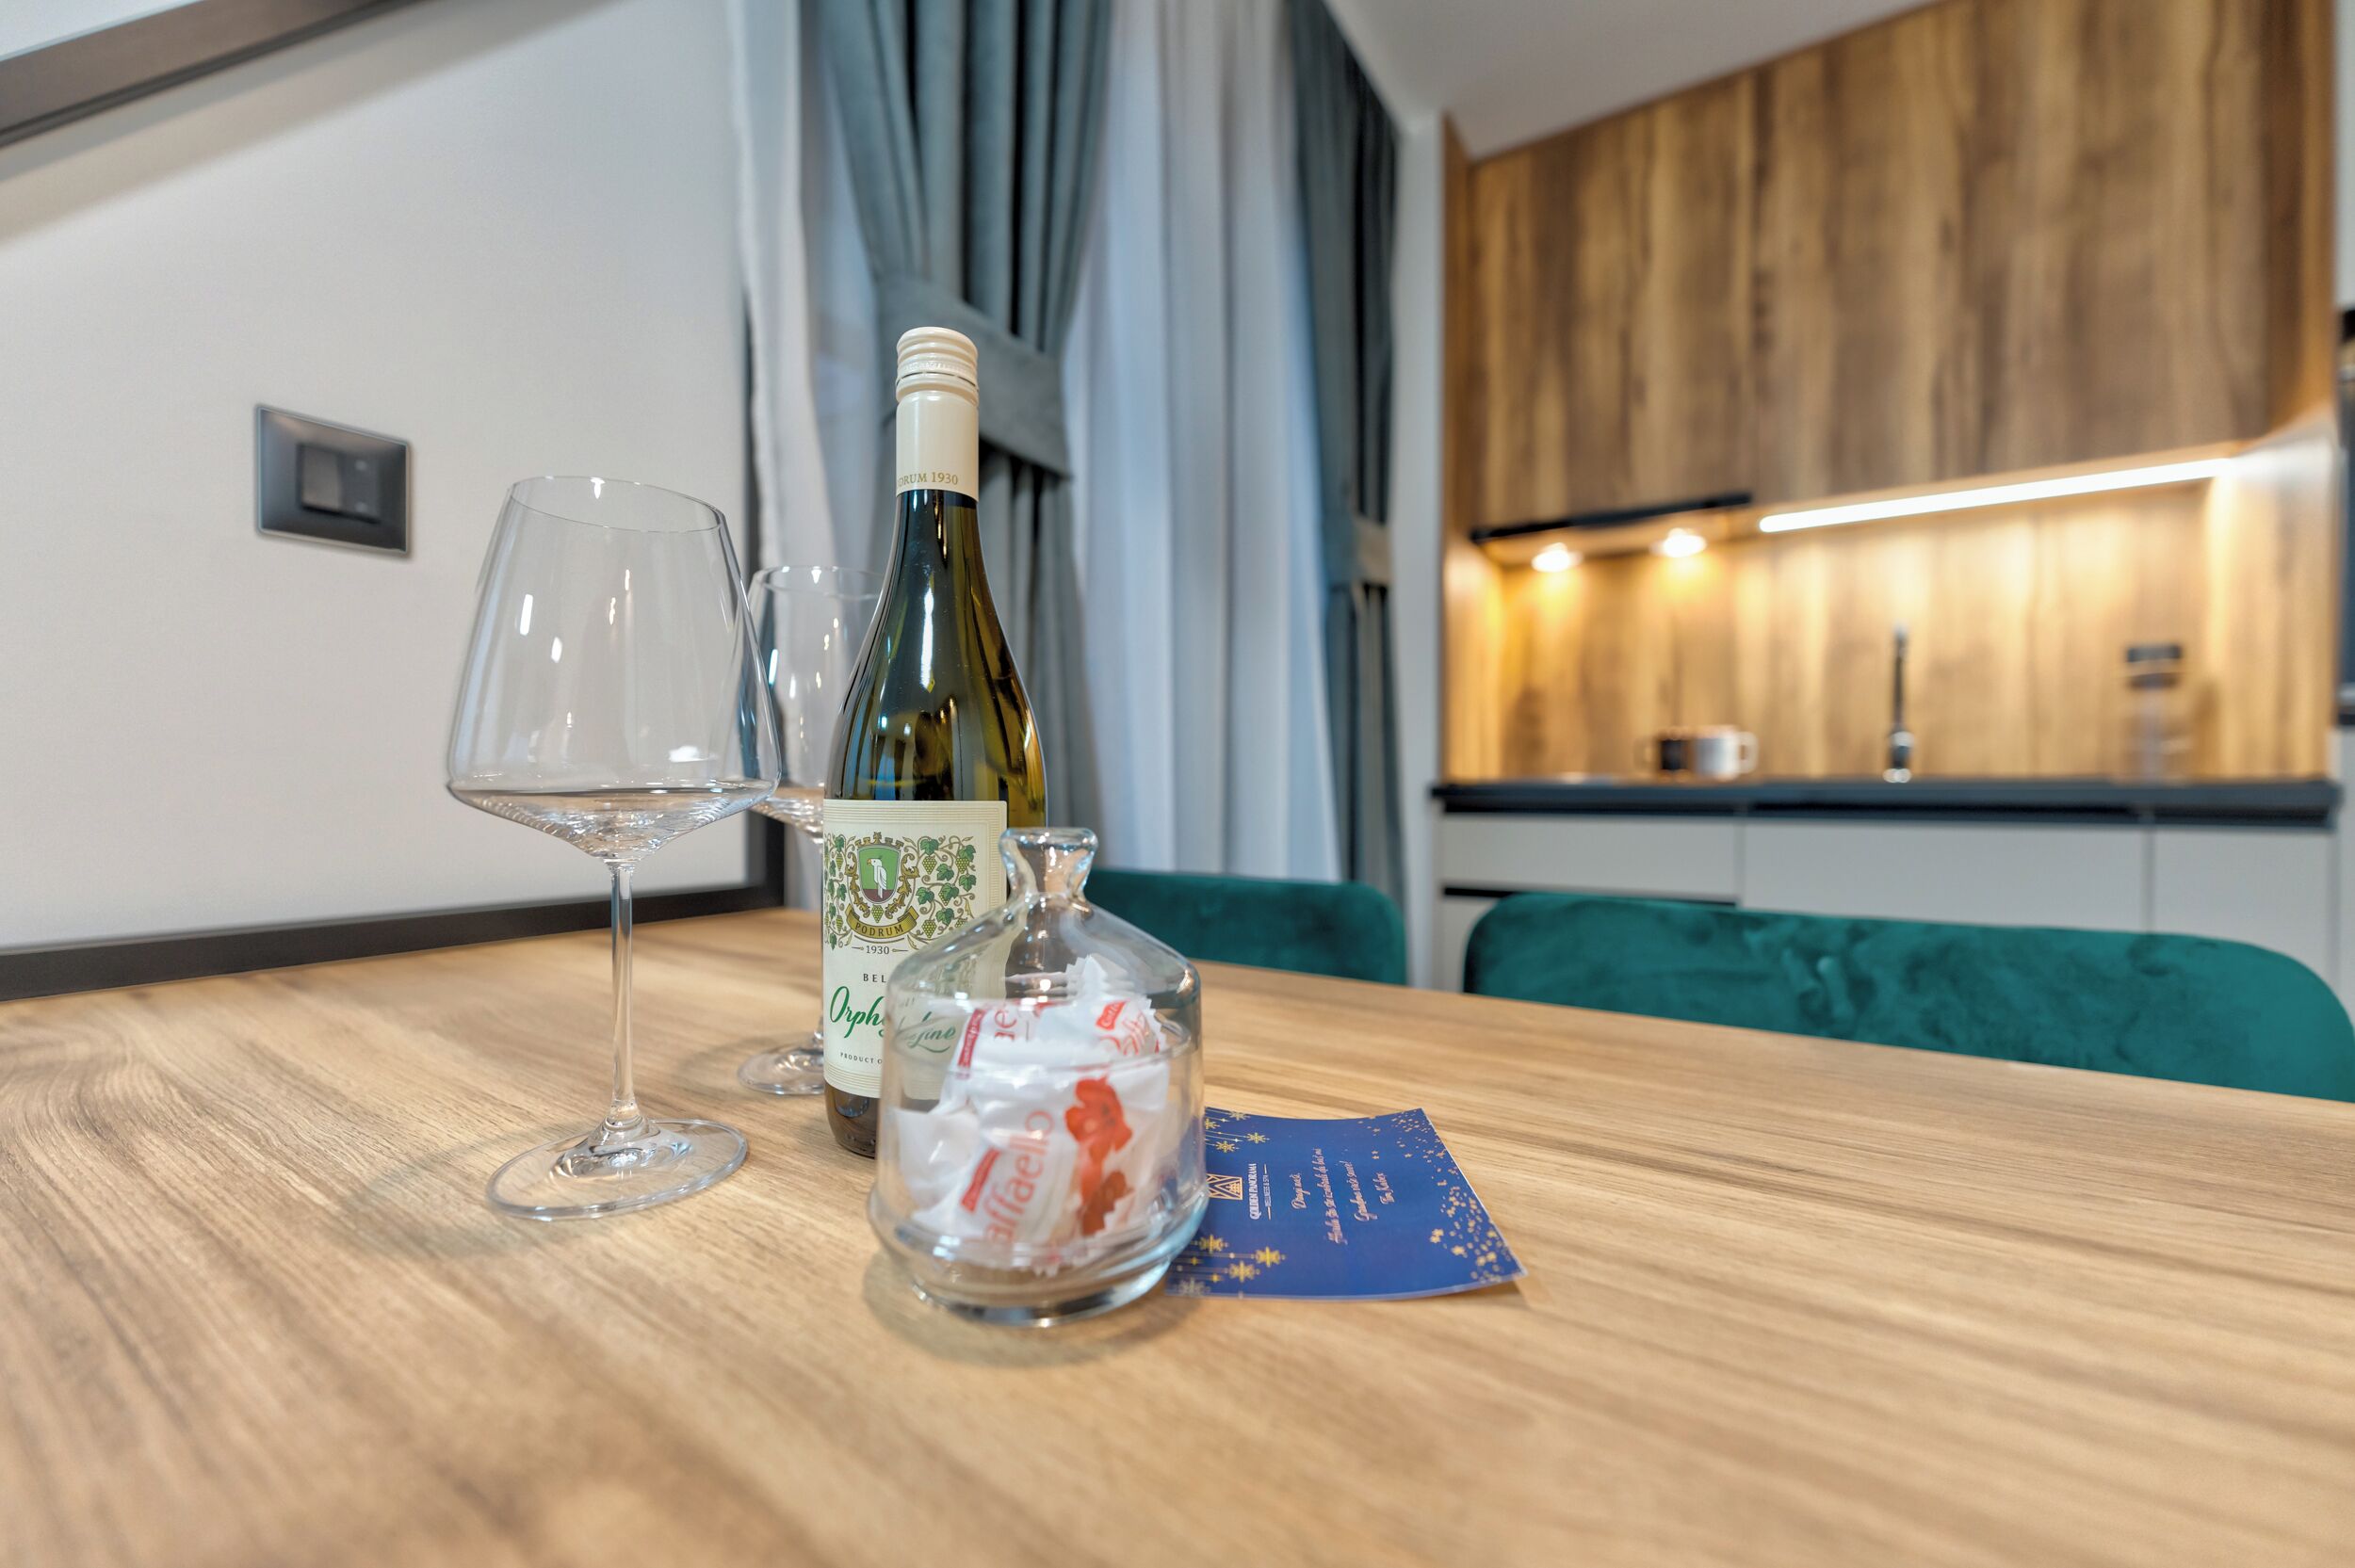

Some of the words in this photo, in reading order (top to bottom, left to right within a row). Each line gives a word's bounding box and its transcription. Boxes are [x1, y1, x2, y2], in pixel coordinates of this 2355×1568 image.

[931, 471, 958, 486] 1930
[854, 923, 904, 937] PODRUM
[866, 945, 890, 956] 1930
[863, 973, 886, 983] BEL
[839, 1052, 875, 1064] PRODUCT
[983, 1109, 1056, 1244] affaello
[1248, 1163, 1259, 1193] PANORAMA
